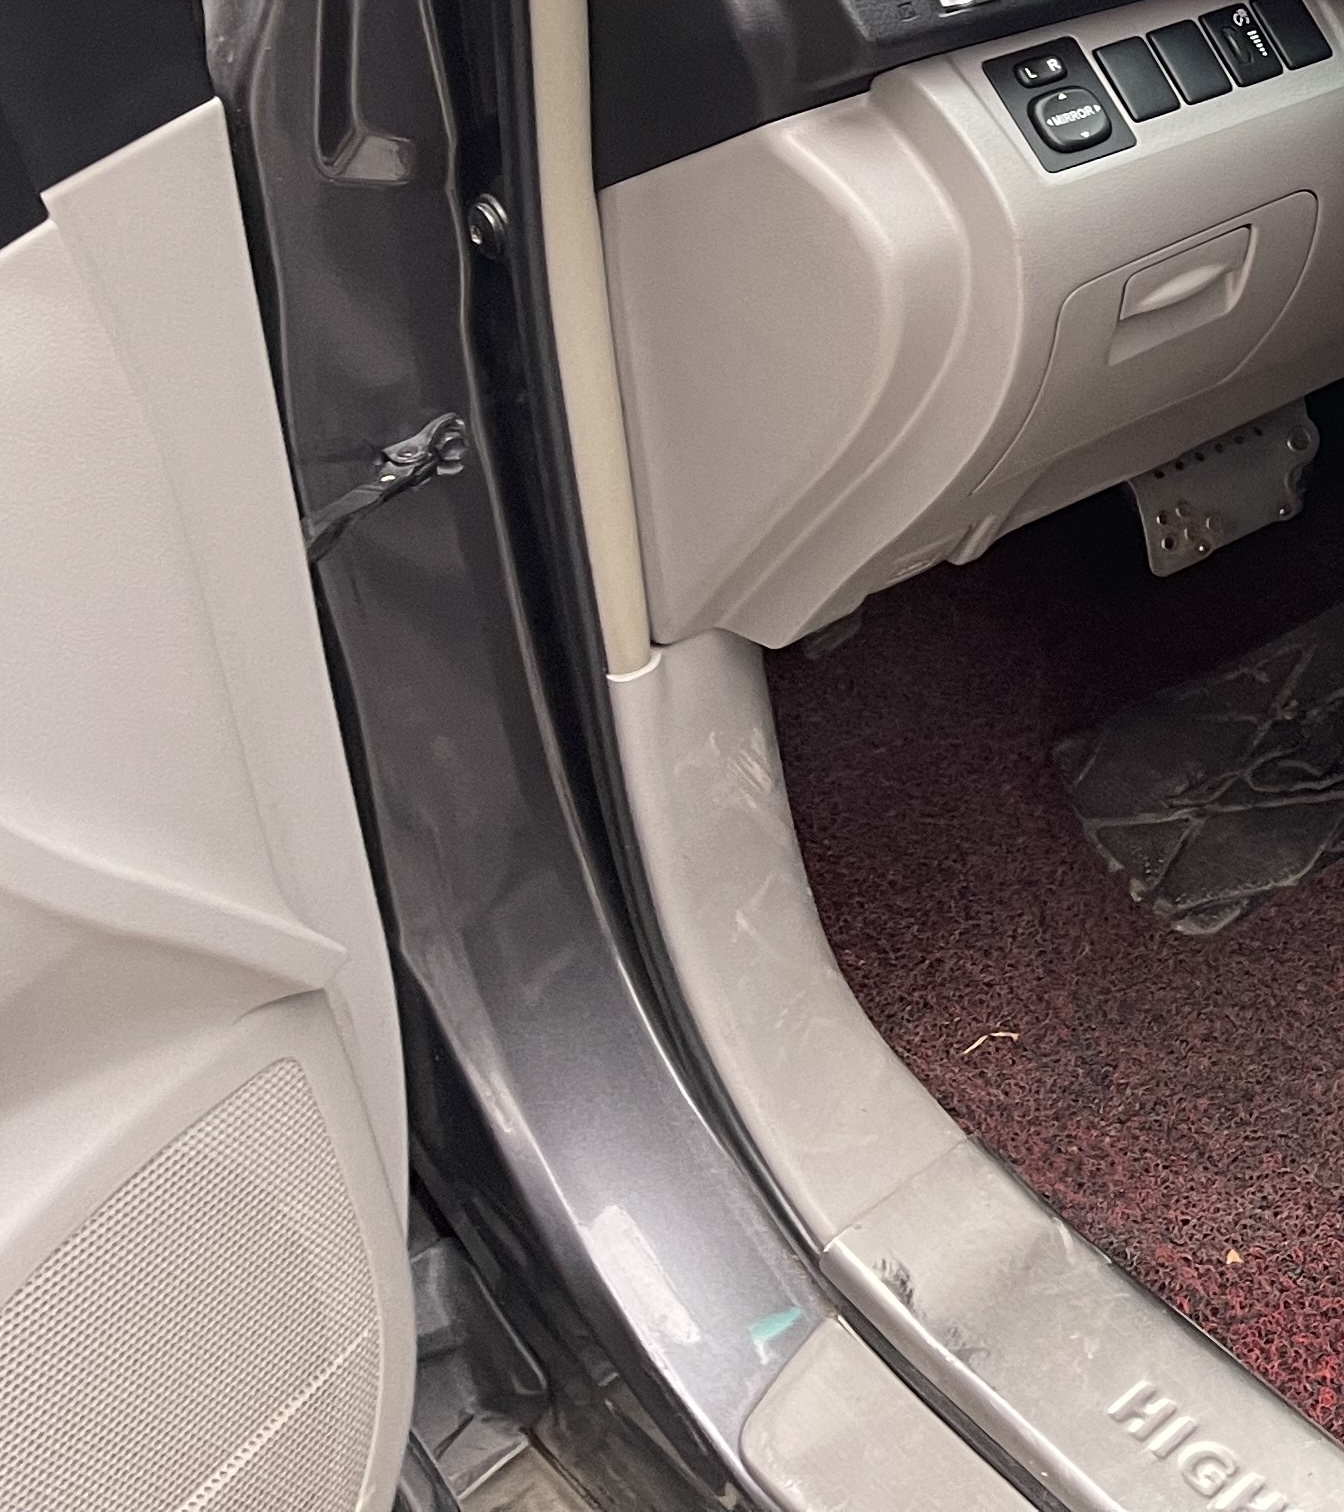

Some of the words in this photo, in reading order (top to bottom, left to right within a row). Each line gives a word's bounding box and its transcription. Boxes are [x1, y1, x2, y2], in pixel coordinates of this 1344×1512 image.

[1024, 67, 1038, 79] L
[1046, 58, 1062, 72] R
[1051, 105, 1096, 126] MIRROR
[1106, 1379, 1306, 1512] HIGH
